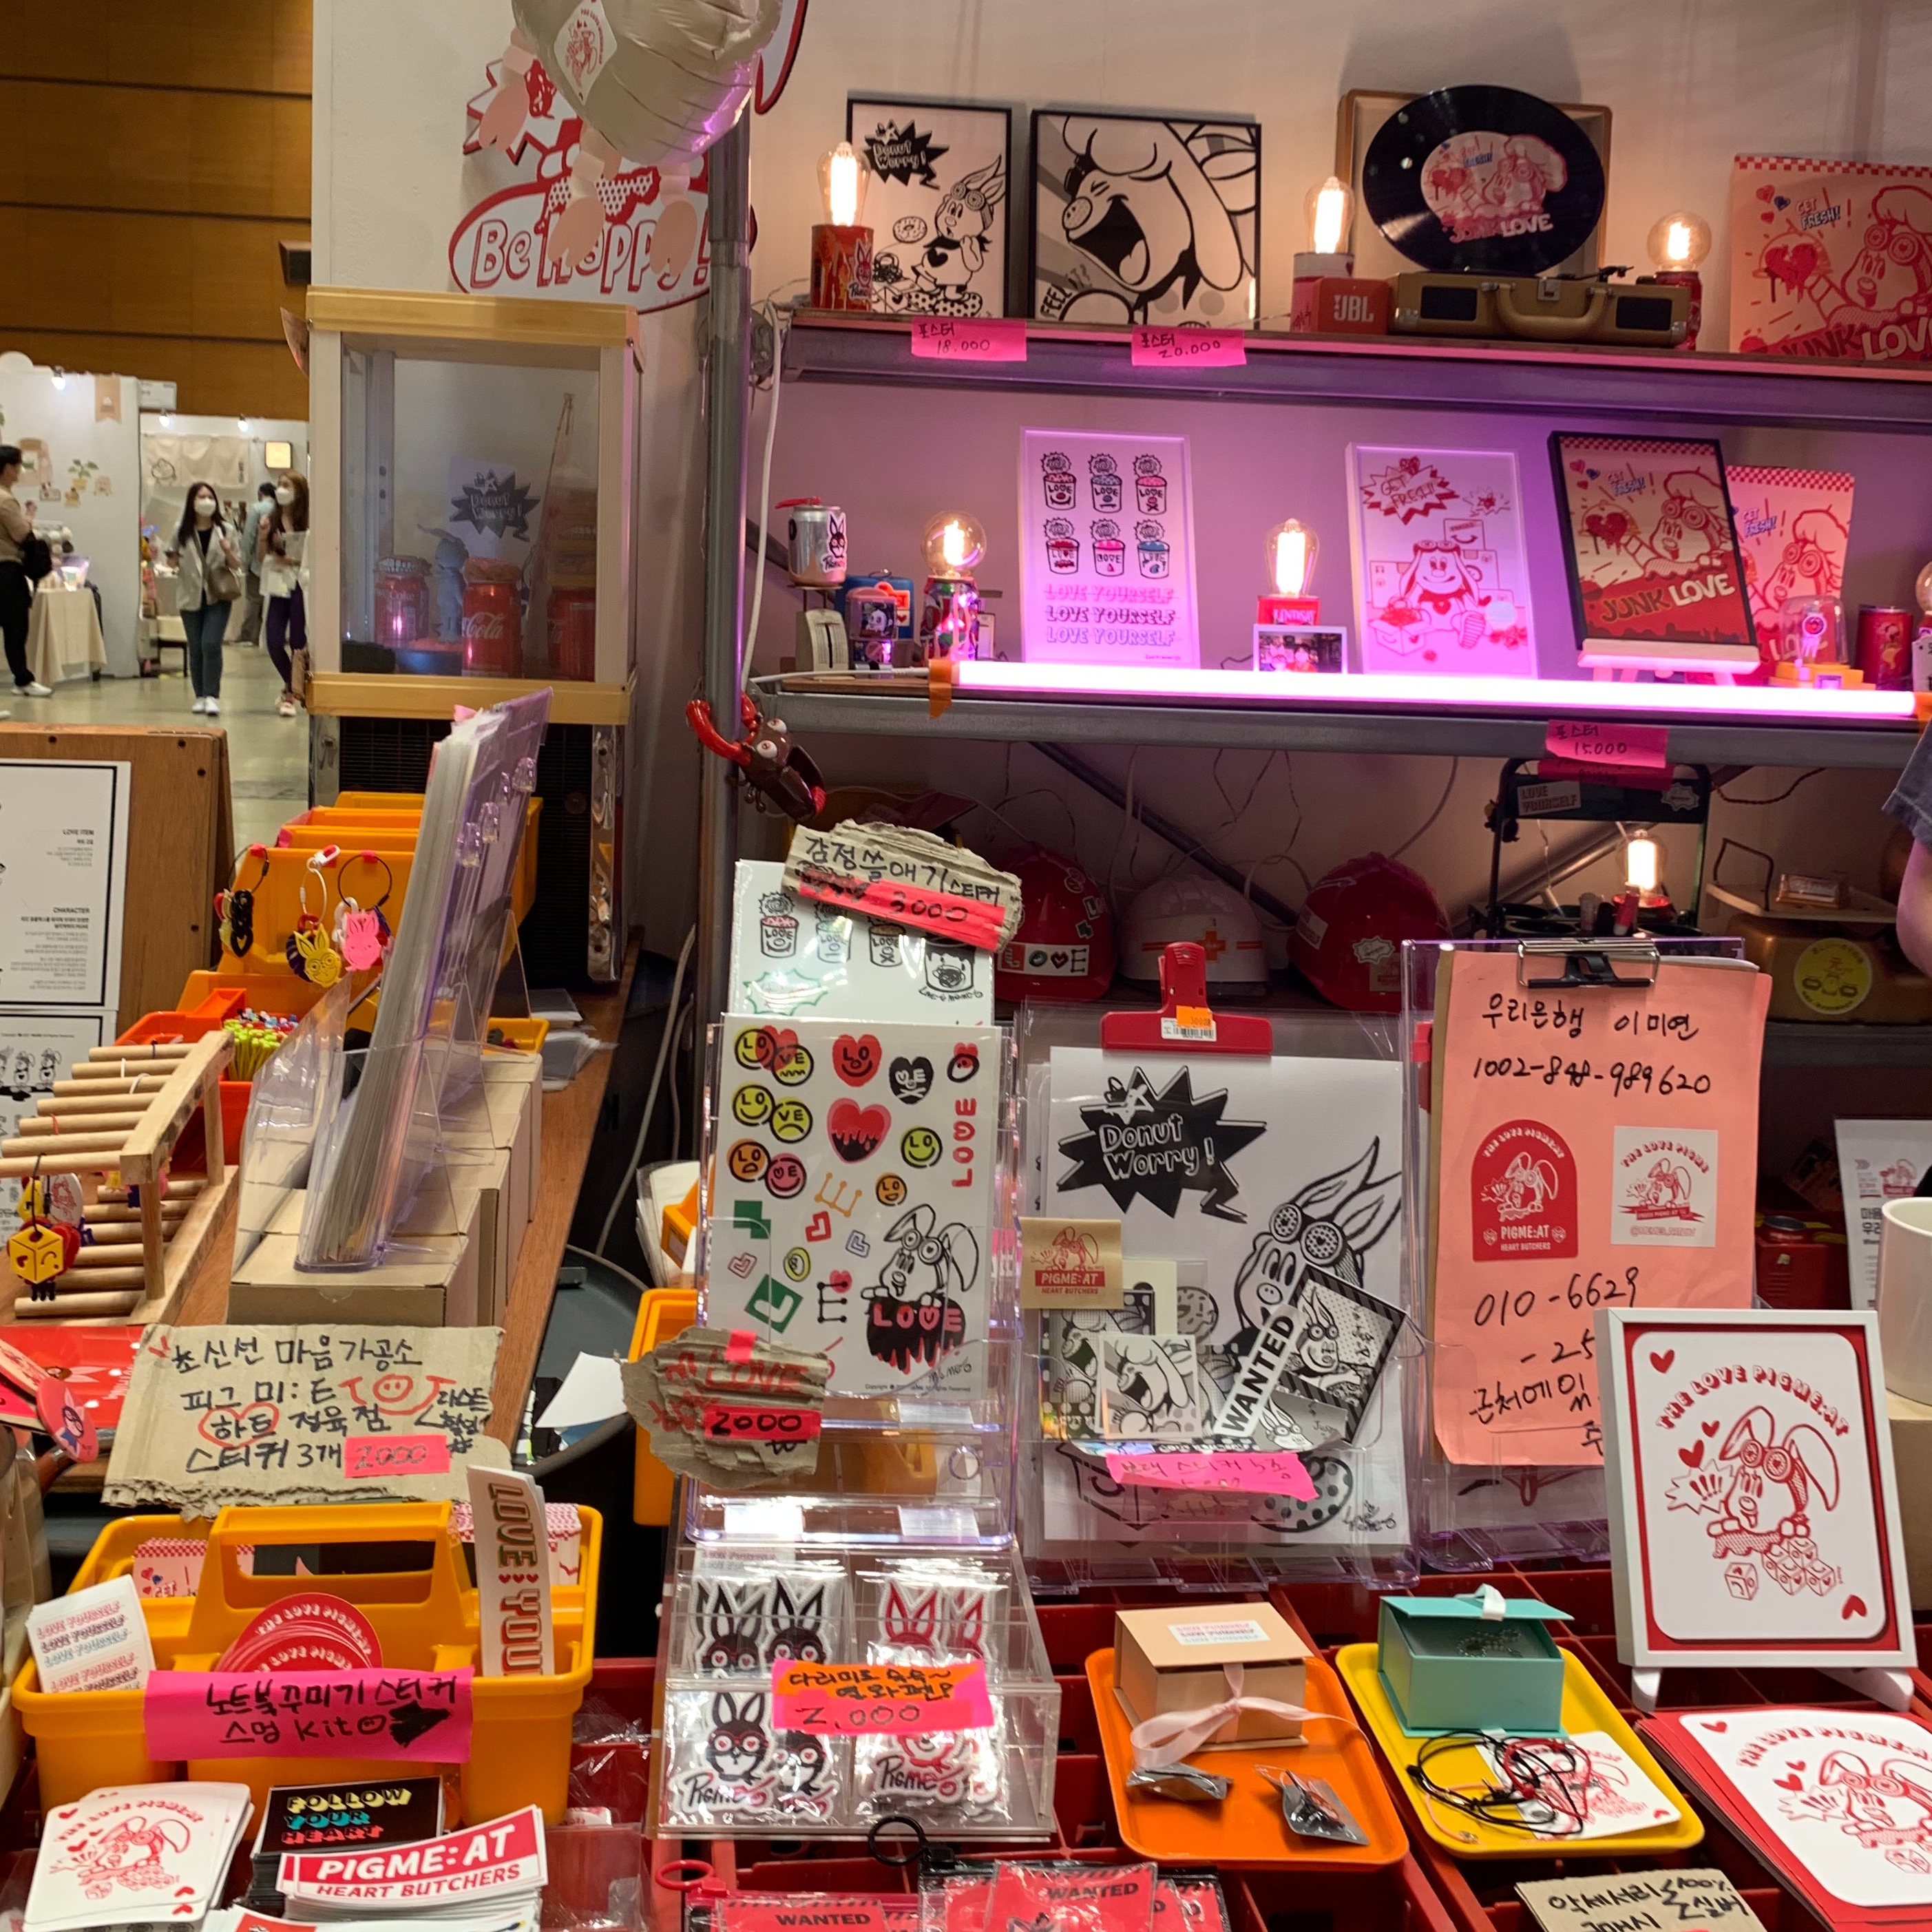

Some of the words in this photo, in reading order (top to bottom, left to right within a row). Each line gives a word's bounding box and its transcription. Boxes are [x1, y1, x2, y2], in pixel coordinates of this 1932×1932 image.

[1500, 214, 1554, 238] LOVE
[470, 218, 532, 290] Be
[1040, 283, 1073, 319] FEEL
[1334, 294, 1375, 322] JBL
[937, 339, 990, 355] 18.000
[1159, 339, 1221, 359] 20.000
[1861, 315, 1932, 361] LOV
[1380, 476, 1405, 496] GET
[1046, 584, 1087, 601] LOVE
[1091, 585, 1175, 605] YOURSELF
[1602, 589, 1672, 622] JUNK
[1668, 573, 1736, 607] LOVE
[1047, 605, 1089, 622] LOVE
[1091, 607, 1175, 625] YOURSELF
[1047, 627, 1089, 644] LOVE
[1093, 629, 1175, 647] YOURSELF
[1574, 742, 1628, 756] 15.000
[1482, 993, 1584, 1038] 우리은행
[1614, 1011, 1701, 1041] 이미연
[1100, 1113, 1184, 1152] Donut
[1040, 1272, 1100, 1286] PIGME:AT
[1040, 1286, 1064, 1295] HEART
[1065, 1286, 1100, 1295] BUTCHERS
[872, 1305, 963, 1332] LOVE
[1221, 1314, 1295, 1433] WANTED
[1469, 1373, 1592, 1425] 근처에있
[1656, 1391, 1695, 1430] THE
[1690, 1364, 1748, 1395] LOVE
[1752, 1365, 1850, 1438] PIGME:AT
[210, 1414, 276, 1440] 하트
[711, 1411, 802, 1436] 2000
[186, 1440, 289, 1474] 스티커
[355, 1445, 428, 1471] 2000
[487, 1482, 538, 1568] LOVE
[285, 1603, 321, 1619] LOVE
[499, 1588, 544, 1676] YOU
[375, 1676, 458, 1705] 스티커
[1755, 1727, 1815, 1747] LOVE
[1814, 1725, 1932, 1761] PIGME:A
[286, 1788, 412, 1814] FOLLOW
[283, 1809, 372, 1831] YOUR
[281, 1825, 384, 1845] HEART
[317, 1824, 516, 1881] PIGME:AT
[316, 1884, 397, 1899] HEART
[400, 1864, 521, 1898] BUTCHERS
[1046, 1882, 1139, 1900] WANTED
[775, 1913, 871, 1926] WANTED
